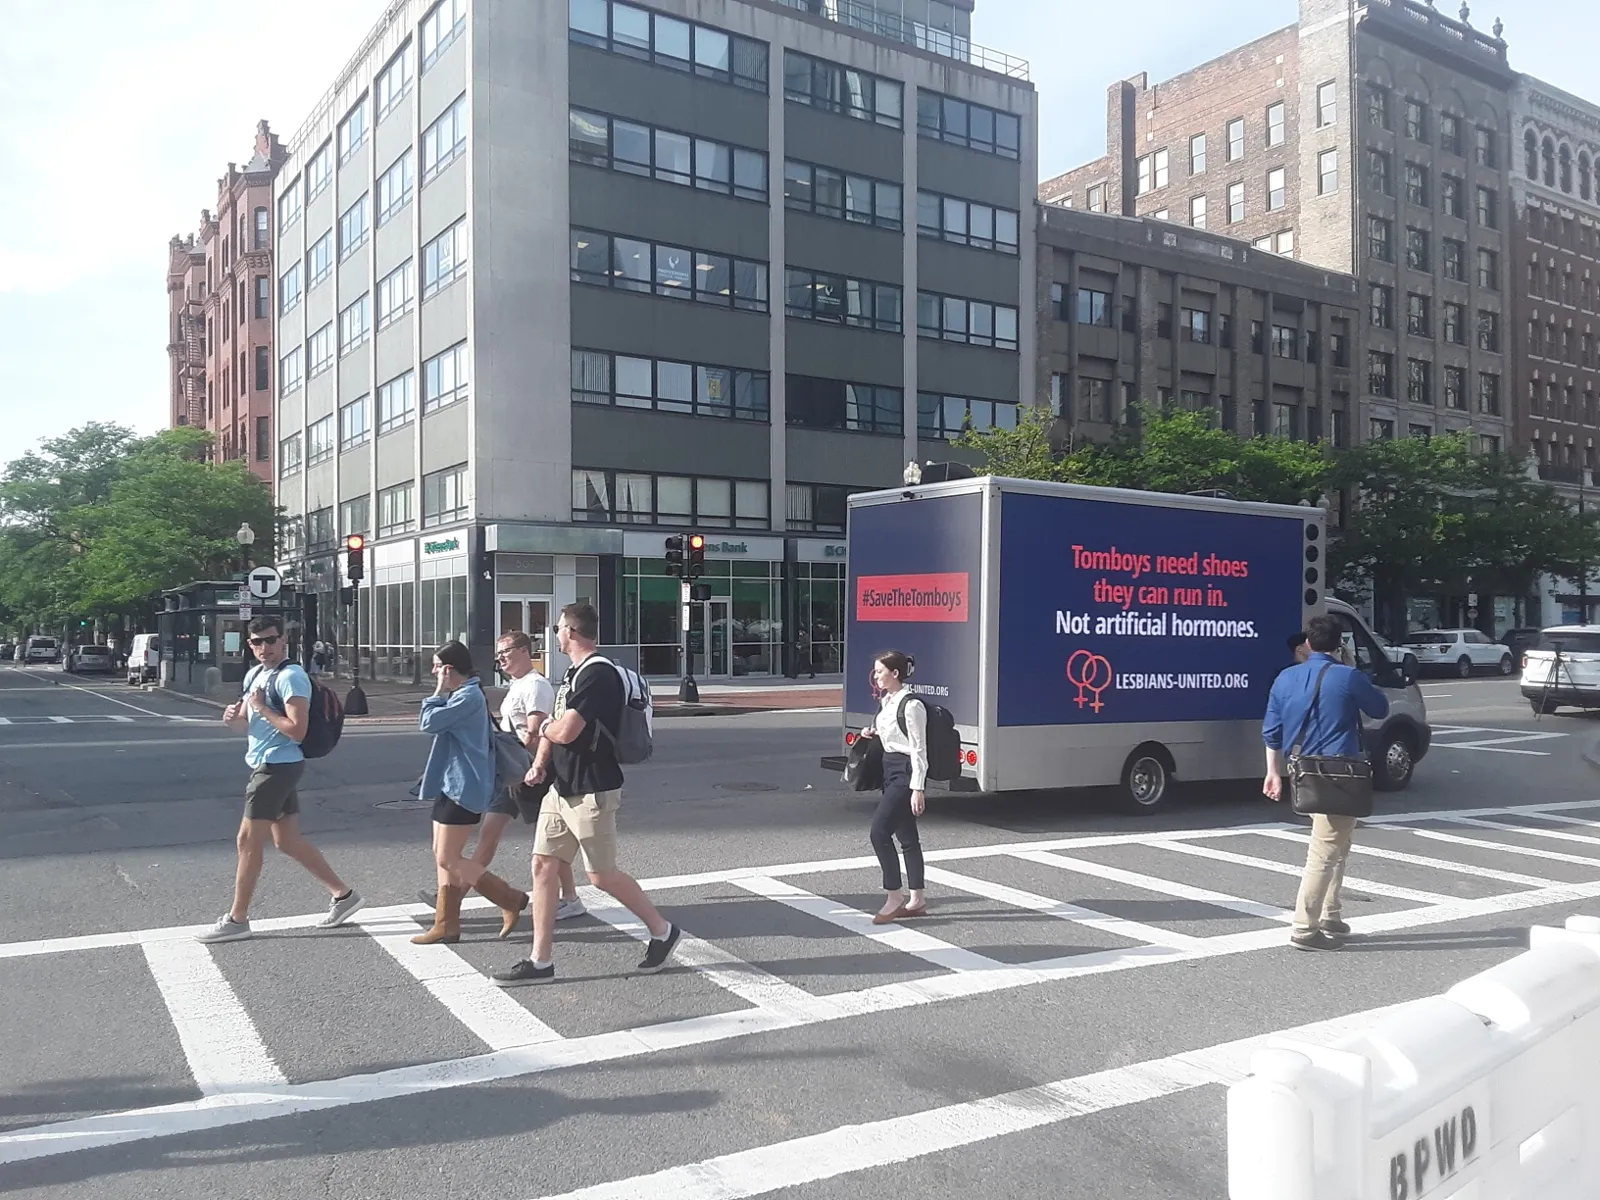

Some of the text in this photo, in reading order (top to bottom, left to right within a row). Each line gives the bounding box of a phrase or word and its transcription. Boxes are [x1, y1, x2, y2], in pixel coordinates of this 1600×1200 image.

[722, 541, 748, 553] Bank
[1071, 544, 1249, 579] Tomboys need shoes
[253, 574, 276, 594] T
[1093, 577, 1228, 611] they can run in.
[862, 586, 962, 612] #SaveTheTomboys
[1056, 610, 1259, 638] Not artificial hormones.
[904, 683, 949, 697] S-UNITED.ORG
[1115, 673, 1249, 689] LESBIANS-UNITED.ORG
[1390, 1105, 1477, 1200] BPWD
